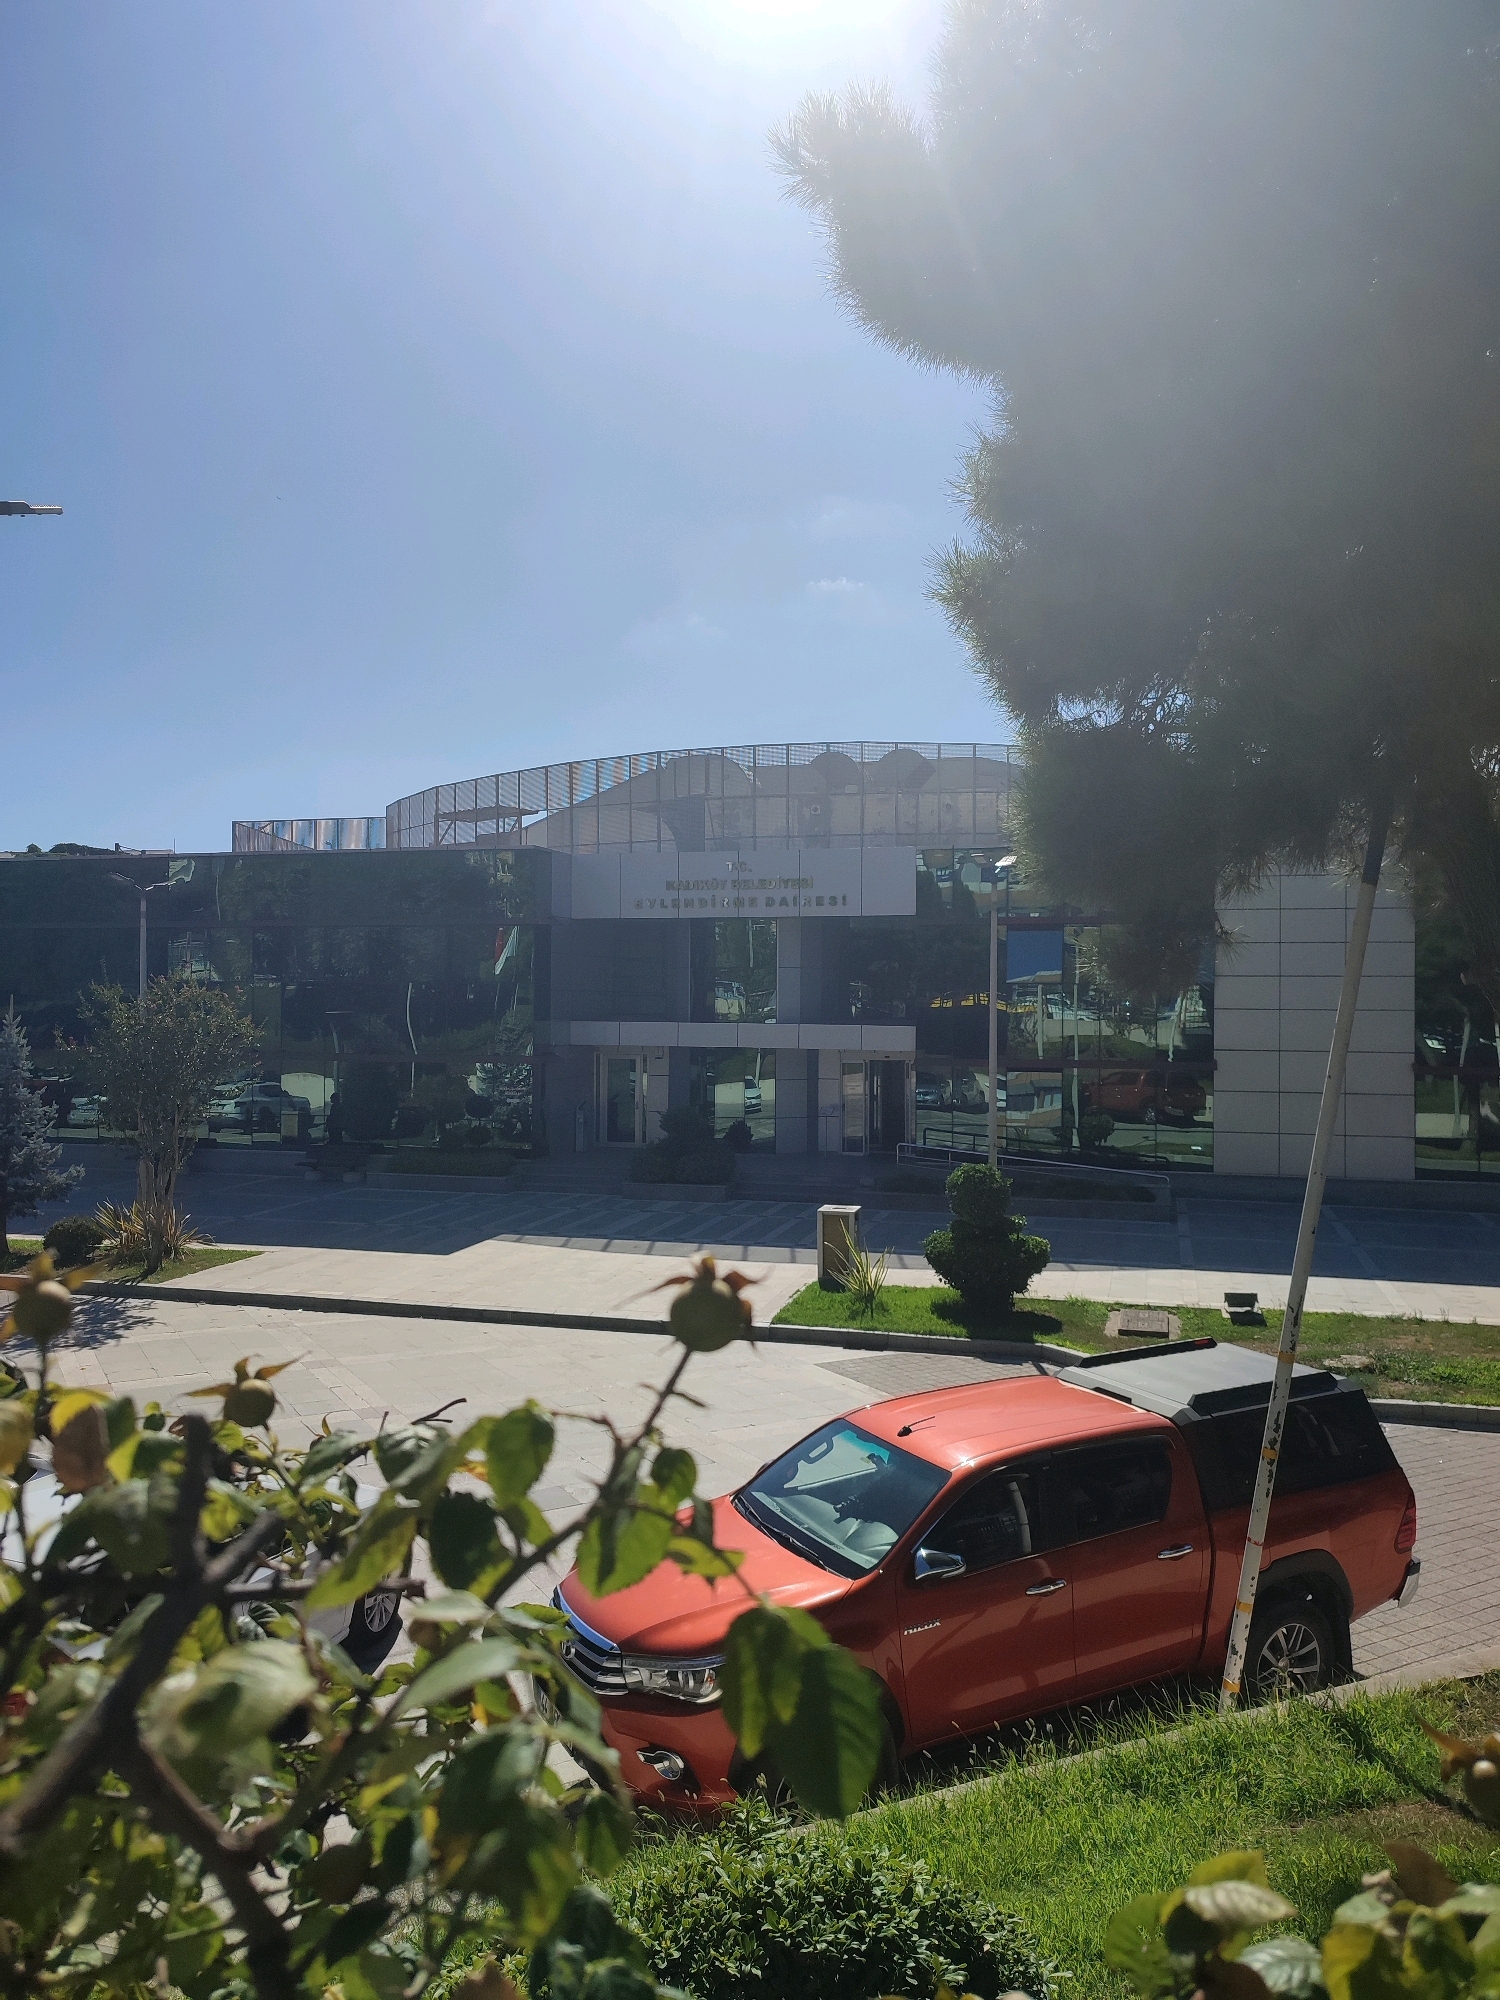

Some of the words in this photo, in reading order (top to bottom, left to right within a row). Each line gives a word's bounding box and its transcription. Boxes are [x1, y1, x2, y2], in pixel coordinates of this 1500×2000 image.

[665, 878, 728, 891] KADIKÖY
[731, 875, 814, 890] BELEDİYESİ
[634, 894, 758, 909] EVLENDİRME
[765, 893, 847, 908] DAİRESİ
